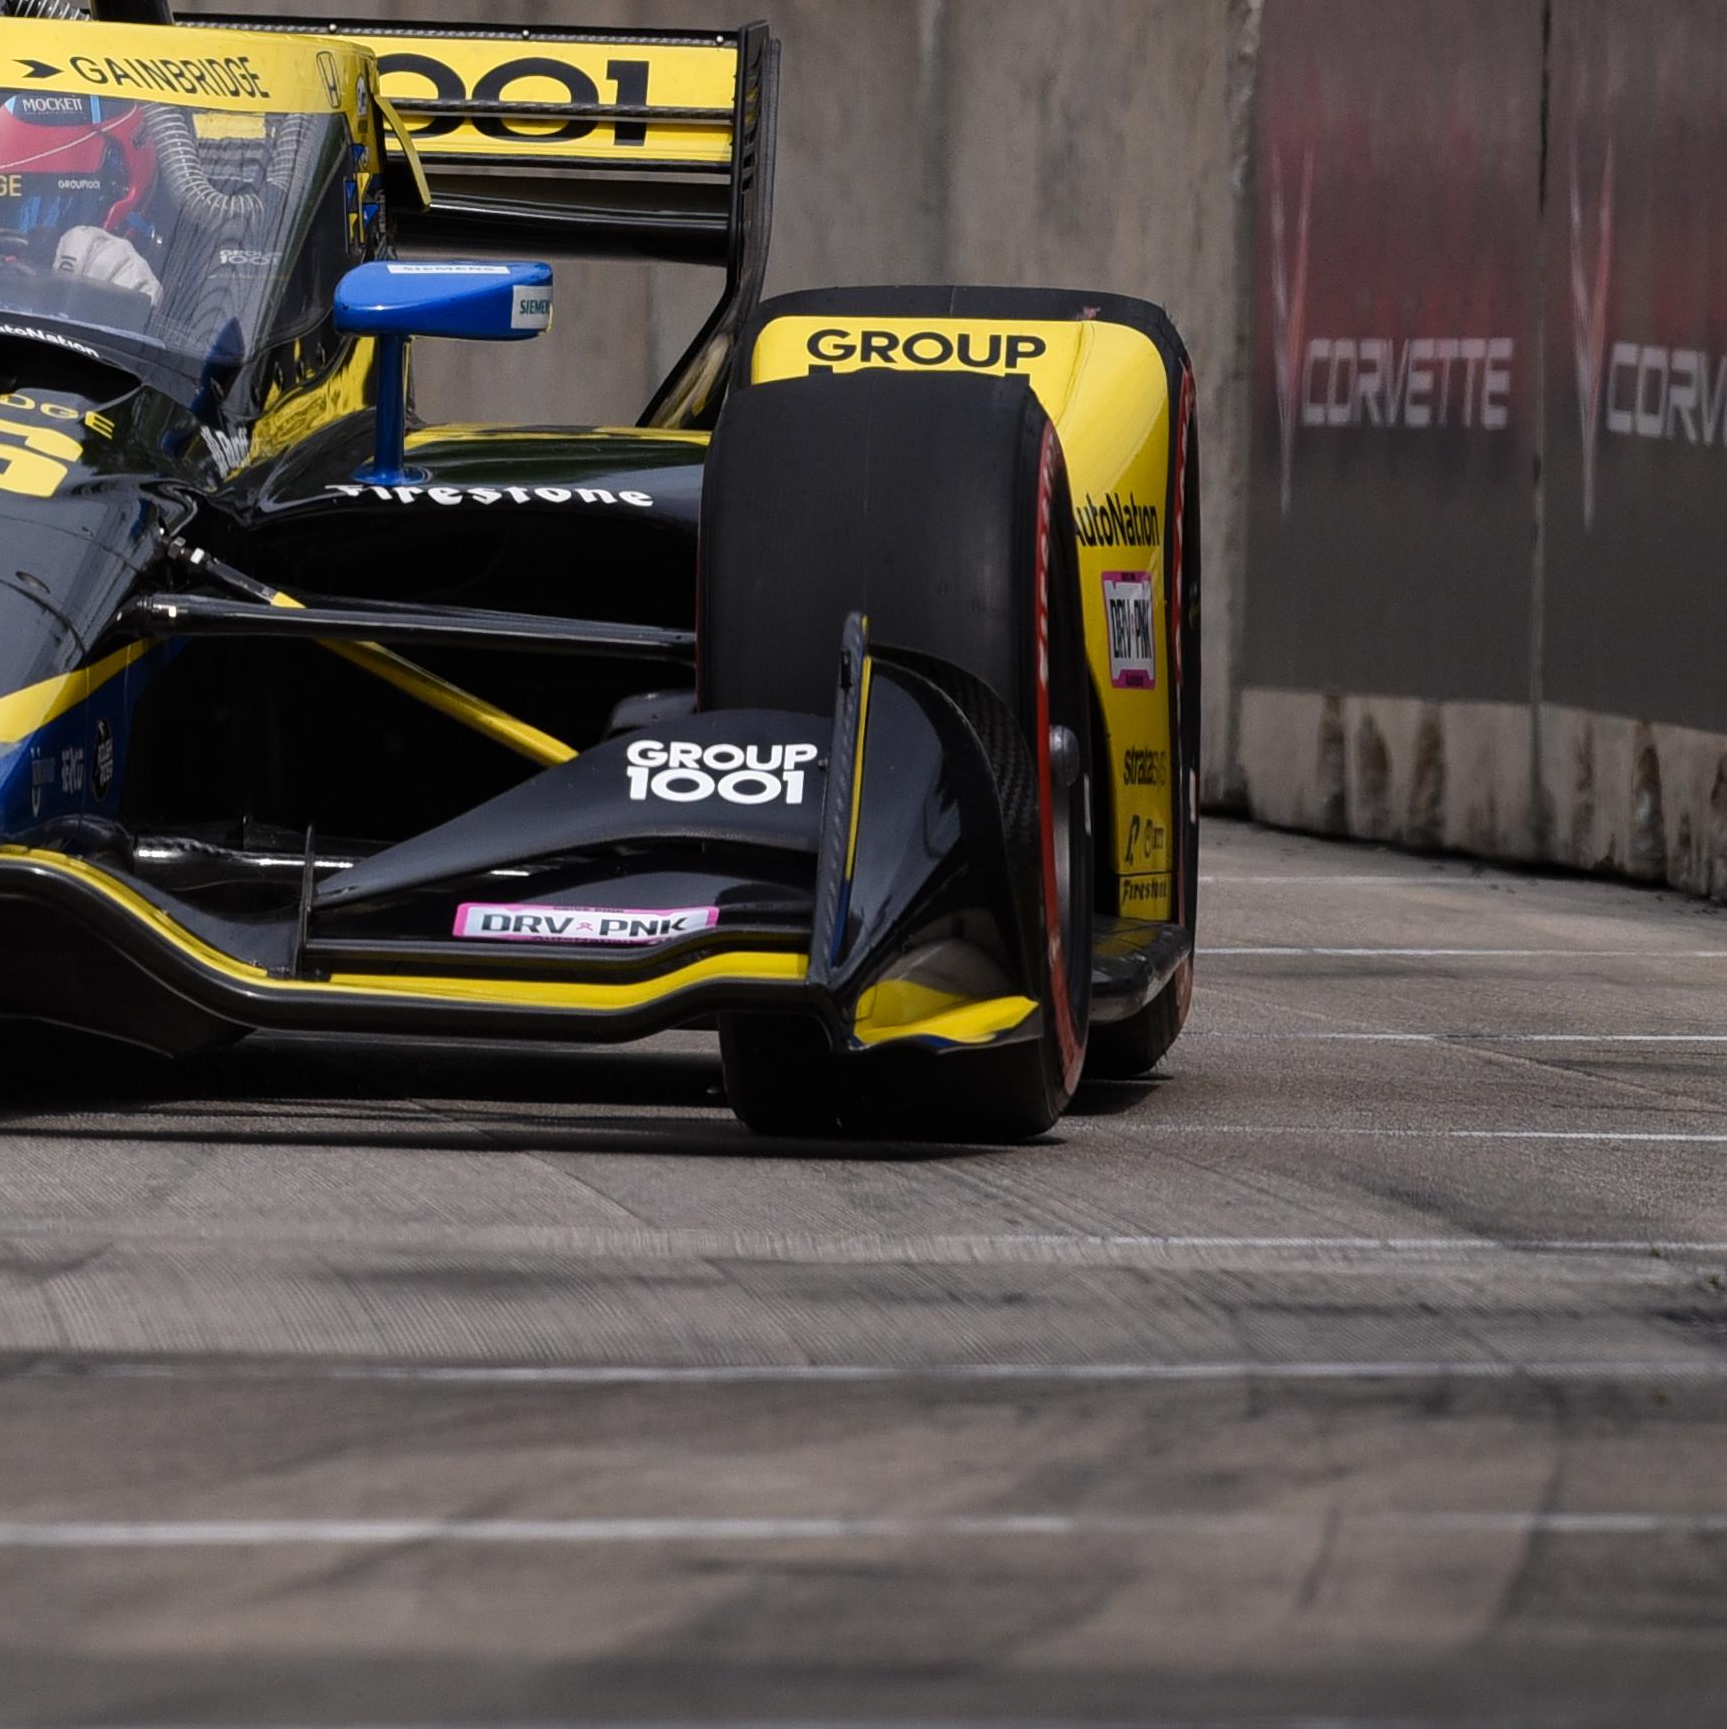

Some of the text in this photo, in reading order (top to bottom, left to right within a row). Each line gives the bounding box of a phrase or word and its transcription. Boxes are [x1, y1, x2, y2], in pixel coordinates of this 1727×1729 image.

[68, 54, 272, 99] GAINBRIDGE
[806, 328, 1047, 369] GROUP
[1302, 338, 1514, 430] CORVETTE
[1606, 342, 1727, 446] CORV
[325, 484, 654, 507] Firestone
[627, 740, 818, 770] GROUP
[627, 766, 804, 805] 1001
[481, 914, 688, 938] DRV PNK
